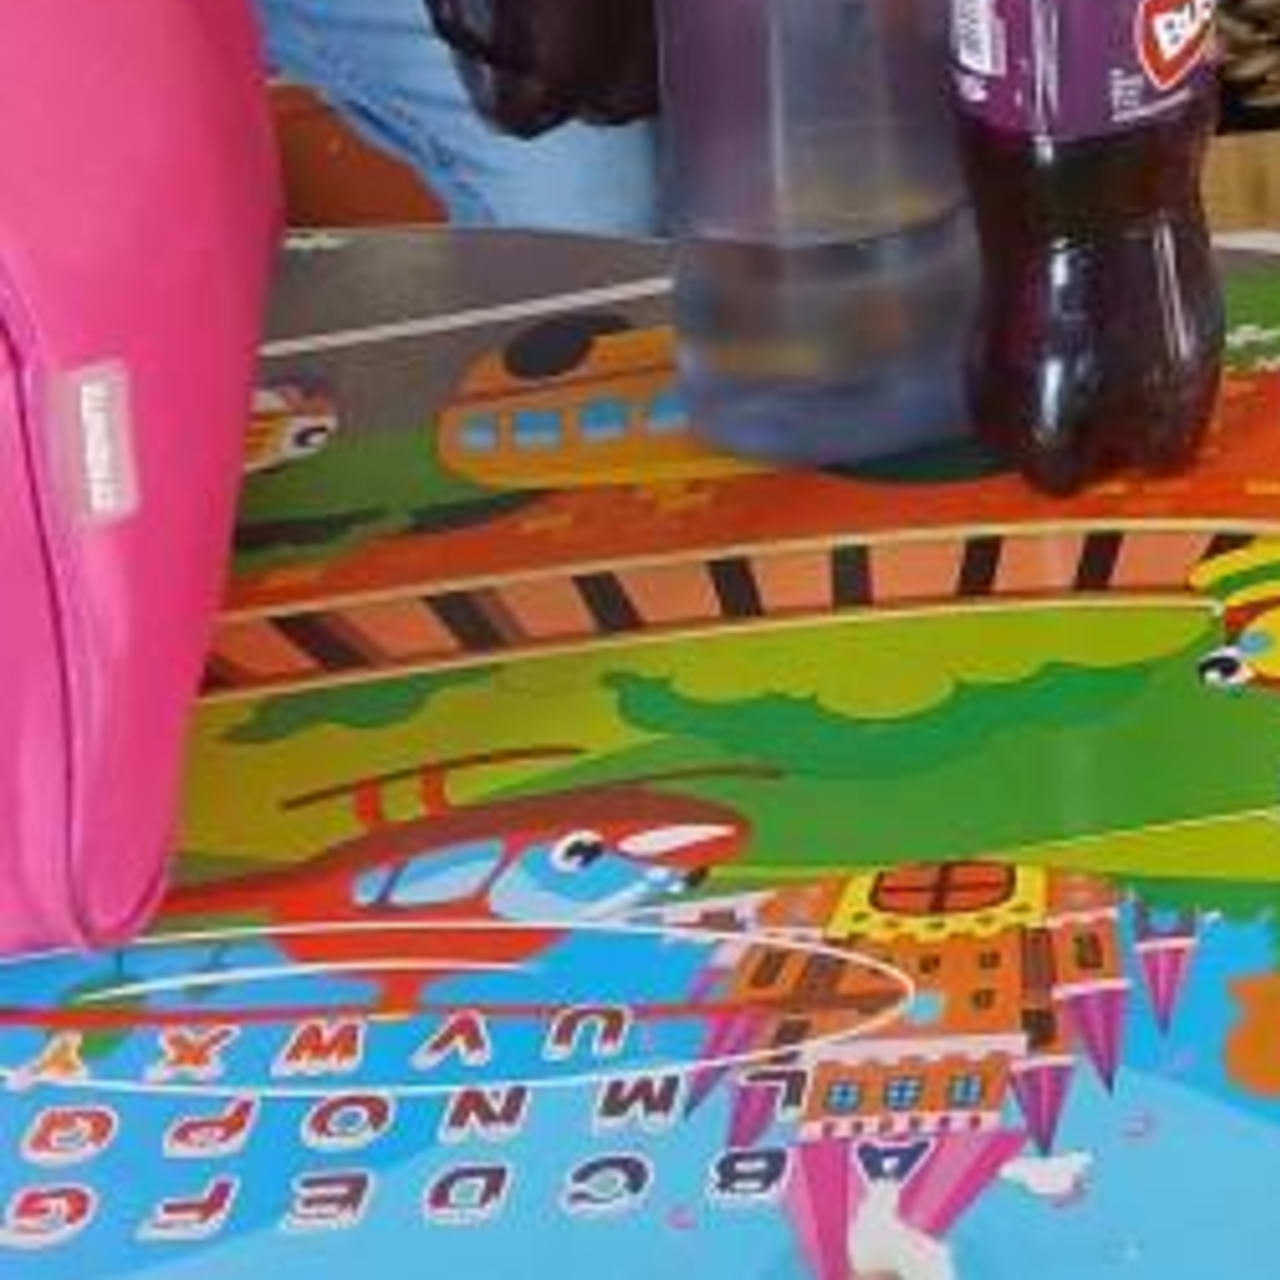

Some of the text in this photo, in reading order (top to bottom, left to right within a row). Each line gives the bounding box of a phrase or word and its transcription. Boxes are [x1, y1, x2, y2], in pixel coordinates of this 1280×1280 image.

[150, 1025, 238, 1080] X
[275, 1018, 365, 1075] W
[413, 1011, 489, 1068] V
[546, 1006, 628, 1059] U
[304, 1093, 392, 1147] O
[442, 1085, 527, 1140] N
[600, 1075, 681, 1127] M
[742, 1070, 808, 1120] L
[164, 1094, 257, 1156] P
[3, 1142, 930, 1246] A B C D E F G
